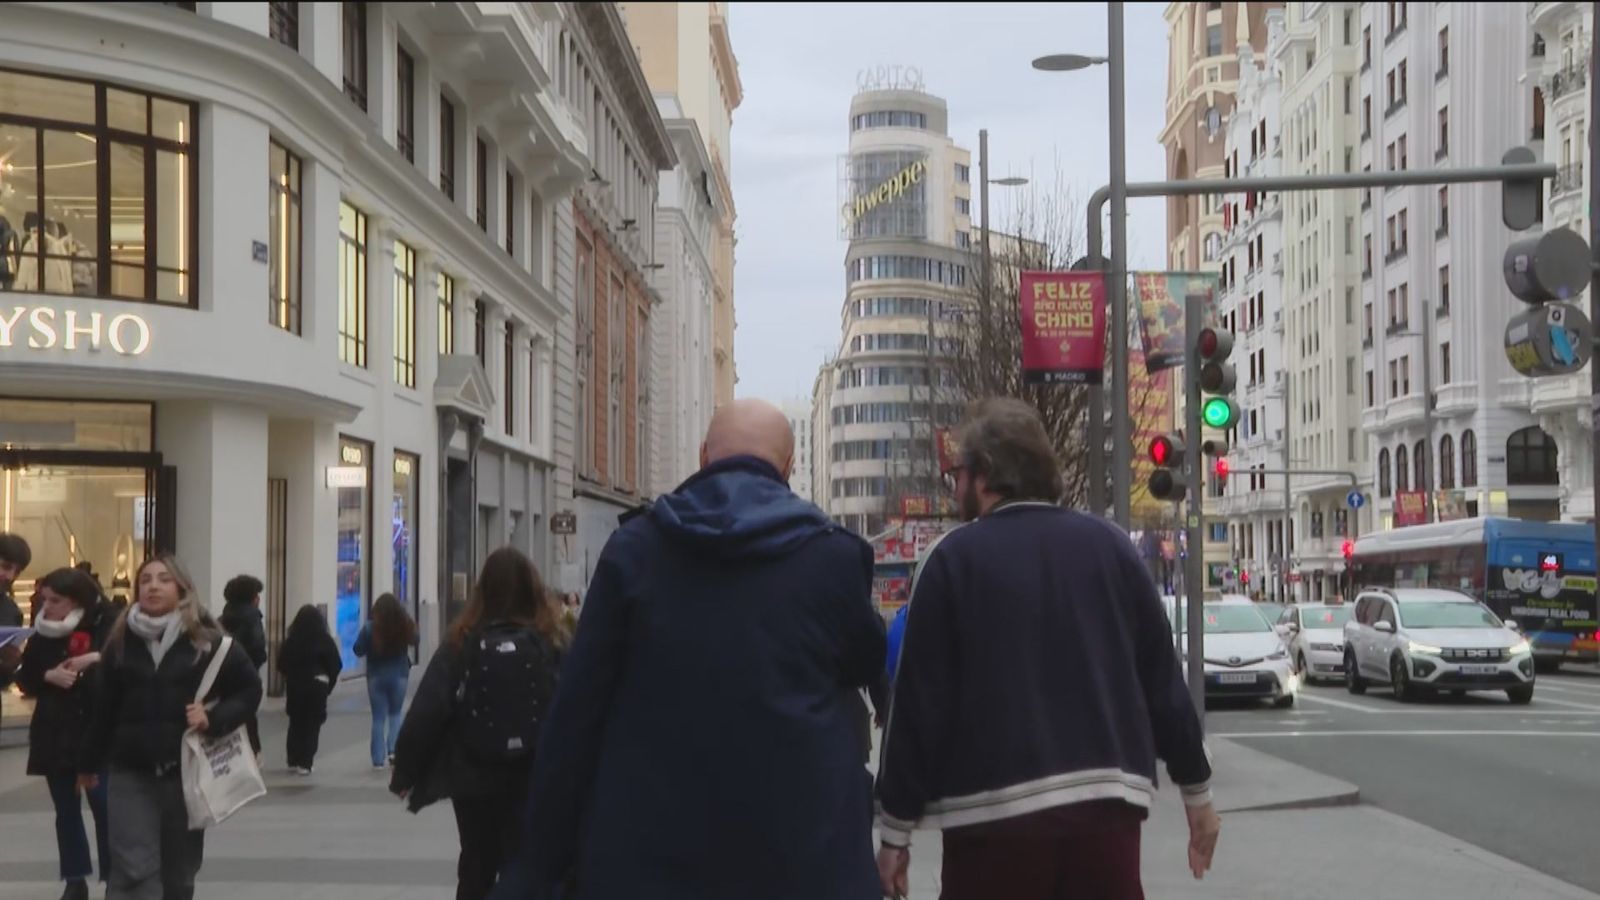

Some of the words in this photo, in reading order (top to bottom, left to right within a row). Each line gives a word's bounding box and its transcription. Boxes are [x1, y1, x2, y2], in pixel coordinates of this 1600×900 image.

[856, 64, 926, 89] CAPITOL
[1033, 282, 1092, 299] FELIZ
[1035, 312, 1094, 329] CHINO
